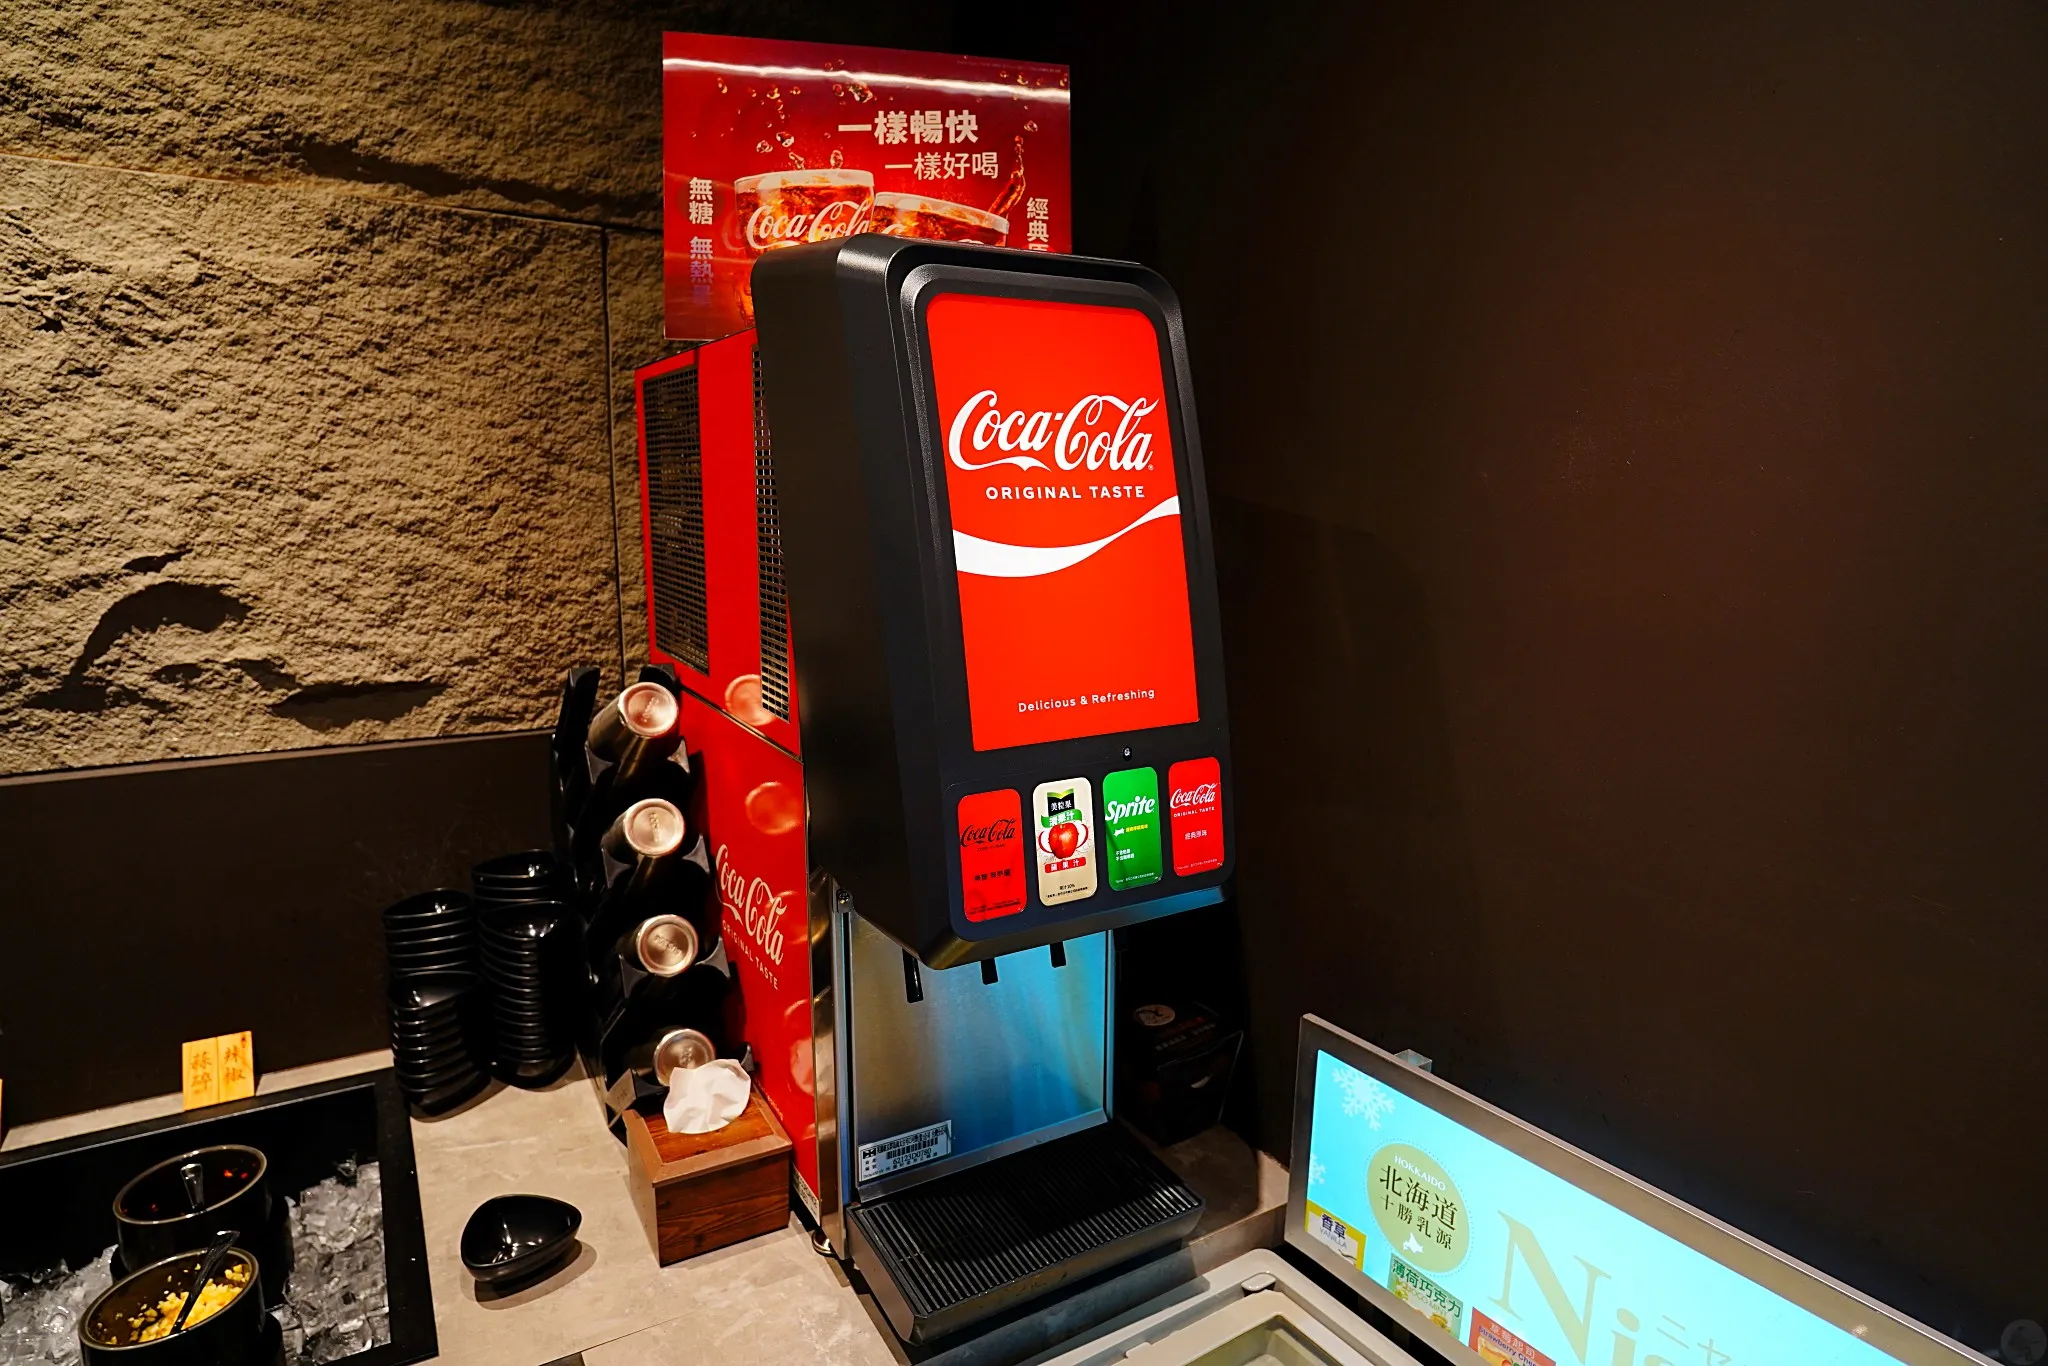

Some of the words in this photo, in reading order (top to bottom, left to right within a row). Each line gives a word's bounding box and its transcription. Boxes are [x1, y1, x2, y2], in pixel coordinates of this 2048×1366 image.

[838, 110, 978, 145] 一樣暢快
[885, 152, 998, 180] 一樣好喝
[689, 177, 713, 225] 無糖
[948, 390, 1159, 472] Coca-Cola
[985, 486, 1082, 500] ORIGINAL
[1089, 485, 1145, 498] TASTE
[1018, 698, 1076, 713] Delicious
[1080, 695, 1088, 705] &
[1092, 690, 1155, 704] Refreshing
[1105, 796, 1155, 824] Sprite
[1170, 783, 1217, 809] Coca-Cola
[1173, 809, 1197, 818] ORIGINAL
[960, 818, 1017, 847] Coca-Cola
[722, 919, 754, 962] ORIGINAL
[755, 956, 778, 990] TASTE
[1394, 1155, 1446, 1191] HOKKAIDO
[1379, 1165, 1458, 1231] 北海道
[1321, 1214, 1347, 1239] 香草
[1379, 1194, 1452, 1250] 十勝乳源
[1319, 1227, 1348, 1250] VANILLA
[1392, 1258, 1462, 1318] 薄荷巧克力
[1479, 1325, 1517, 1356] Strawberry
